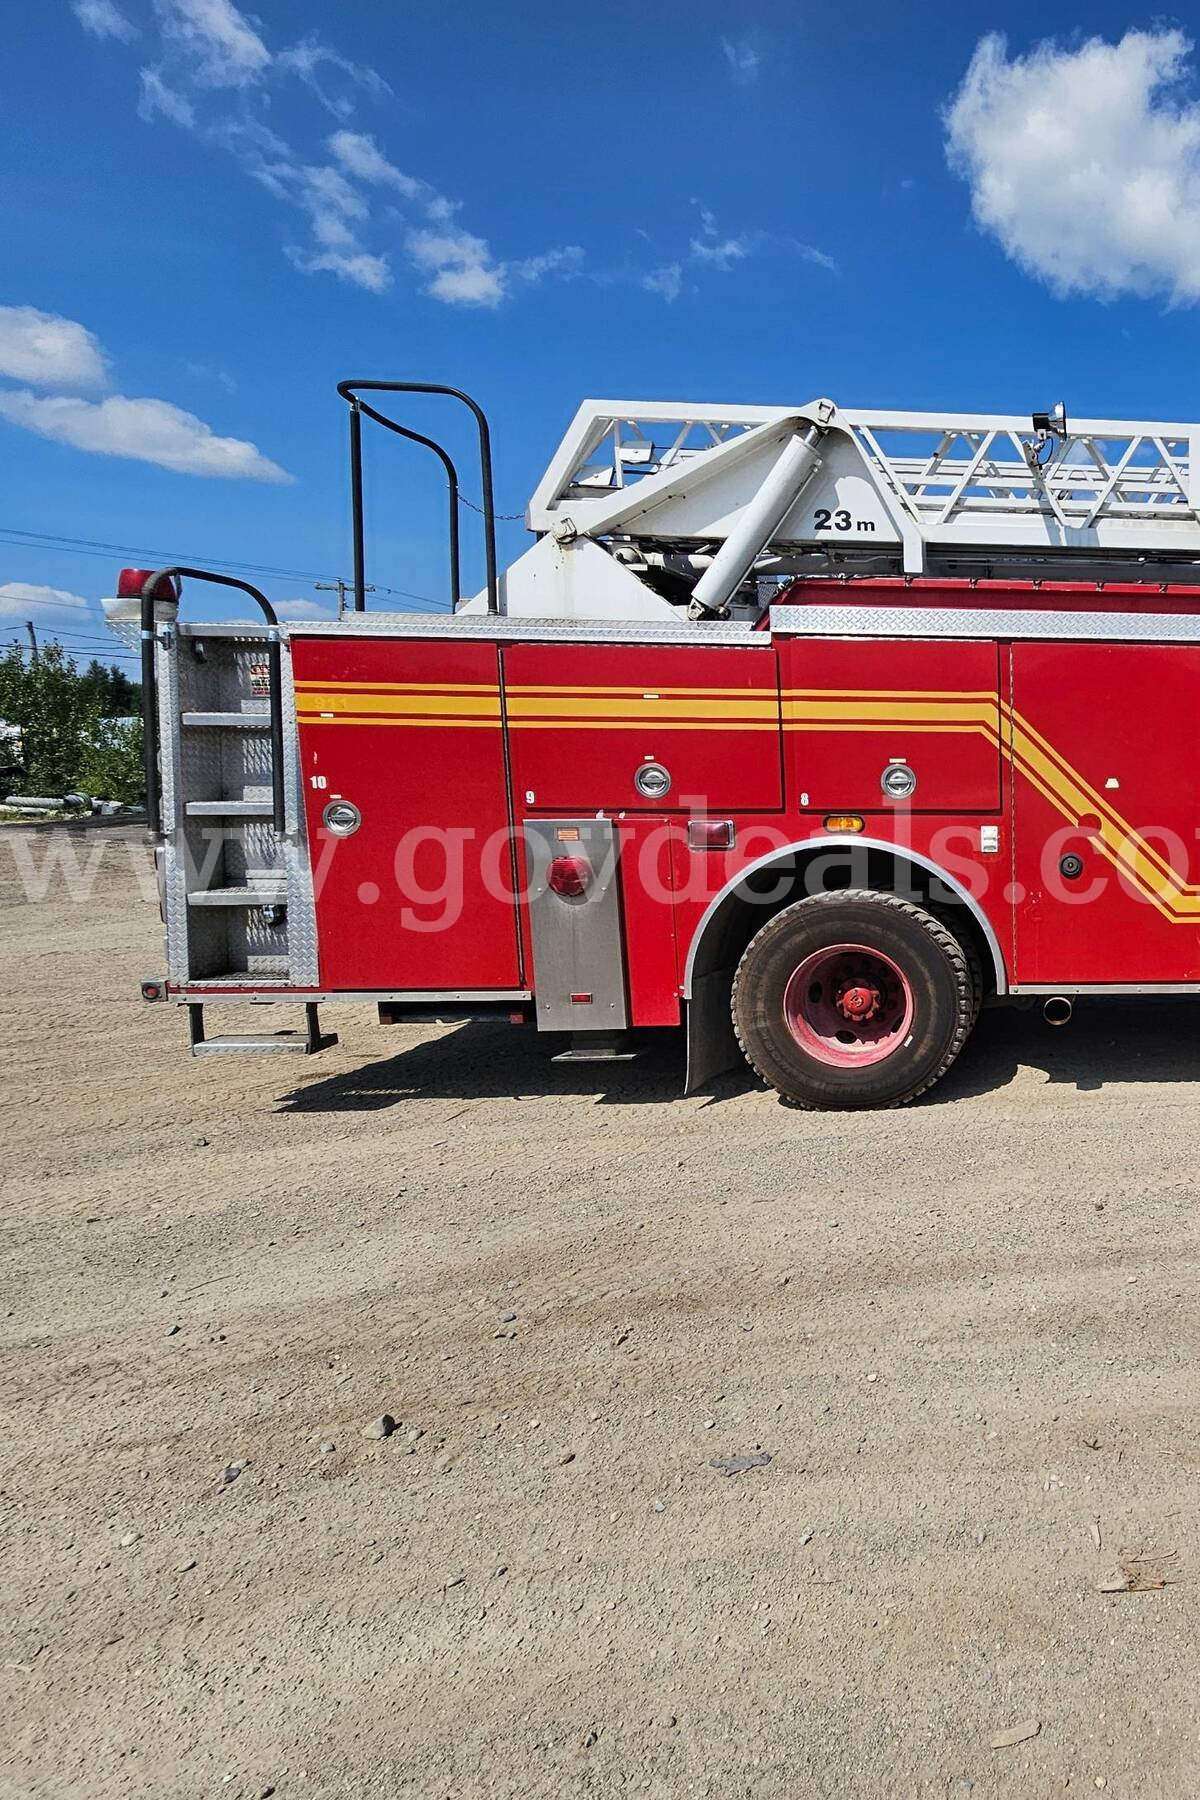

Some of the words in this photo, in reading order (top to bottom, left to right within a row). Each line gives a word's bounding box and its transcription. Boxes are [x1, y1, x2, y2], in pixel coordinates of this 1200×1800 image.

[813, 509, 852, 531] 23
[857, 521, 875, 531] m
[309, 775, 327, 789] 10
[525, 790, 535, 804] 9
[800, 792, 809, 806] 8
